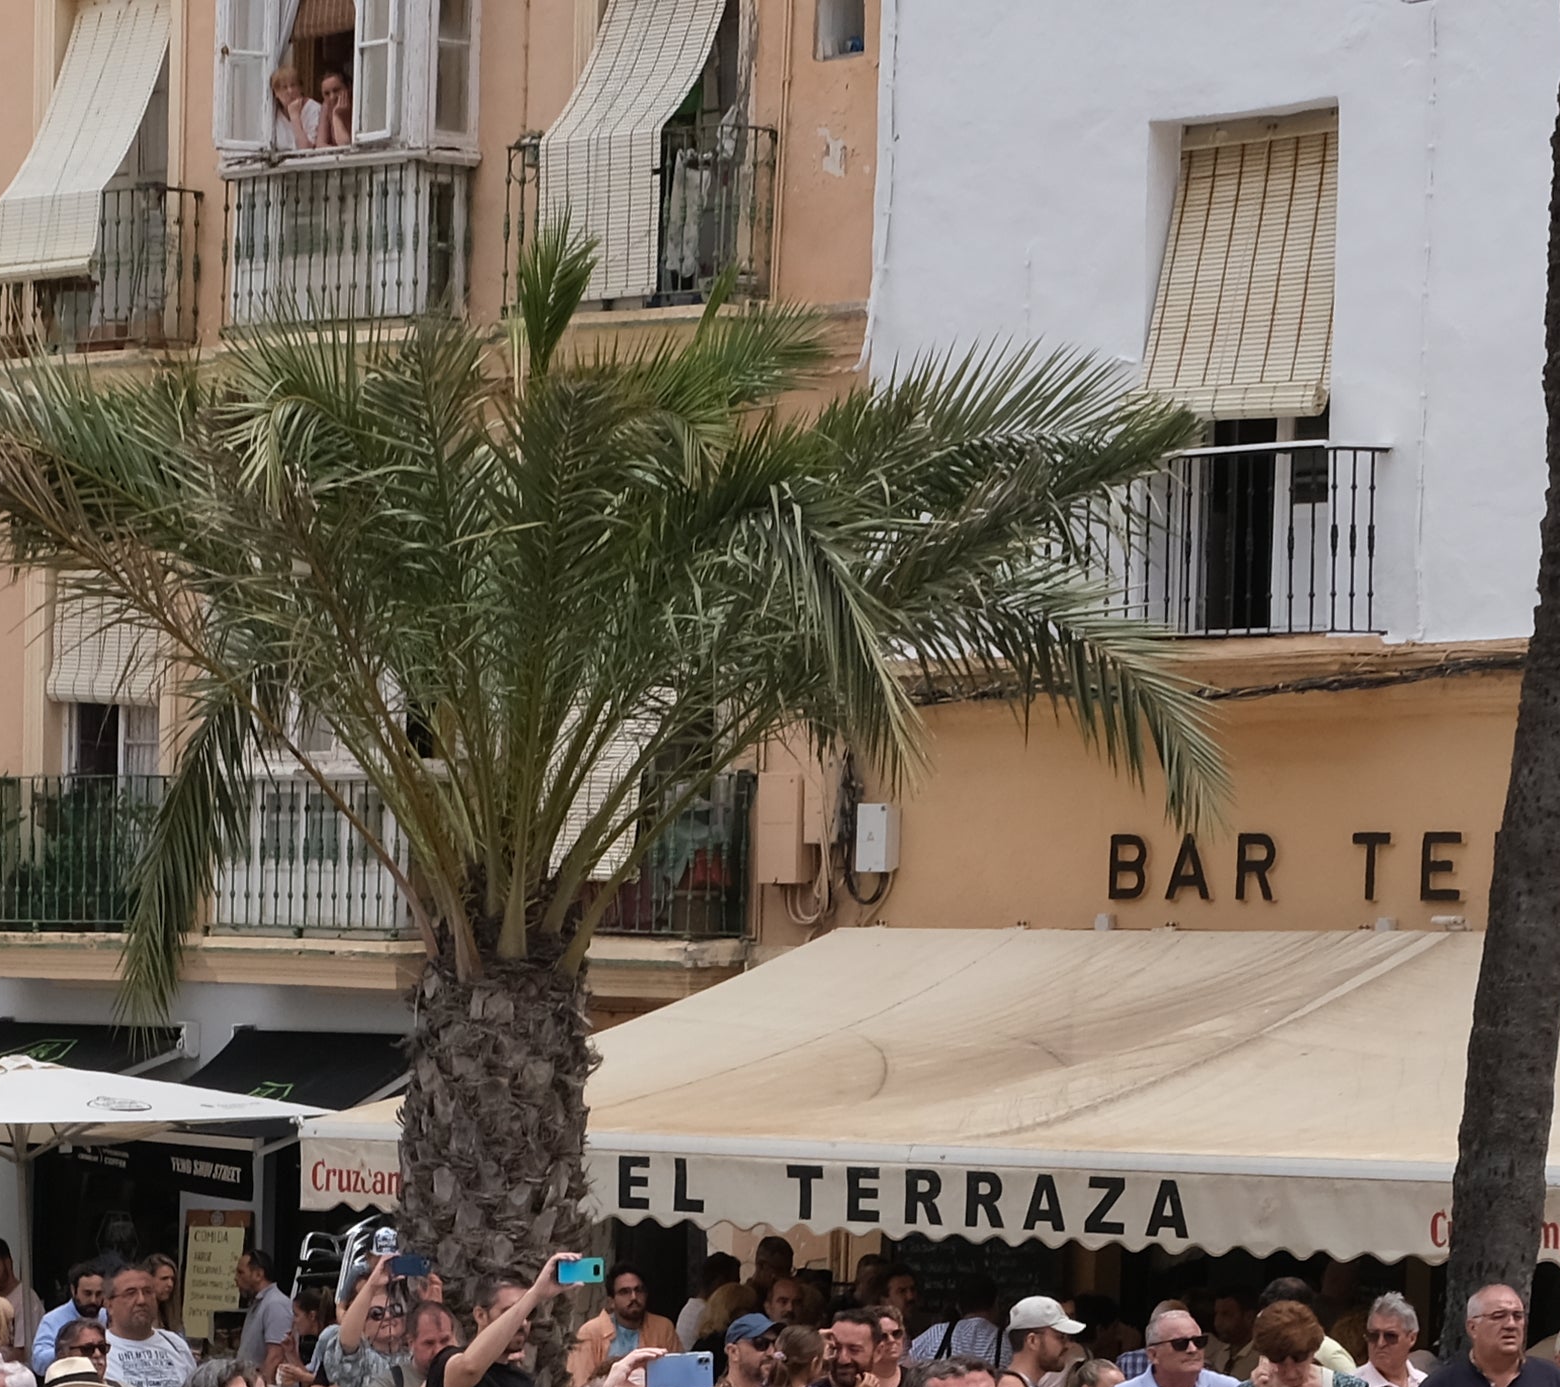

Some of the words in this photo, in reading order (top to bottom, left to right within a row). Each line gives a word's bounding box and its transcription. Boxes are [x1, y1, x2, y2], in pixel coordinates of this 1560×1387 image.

[1109, 832, 1275, 901] BAR
[618, 1155, 705, 1214] EL
[786, 1164, 1190, 1240] TERRAZA
[194, 1230, 229, 1244] COMIDA
